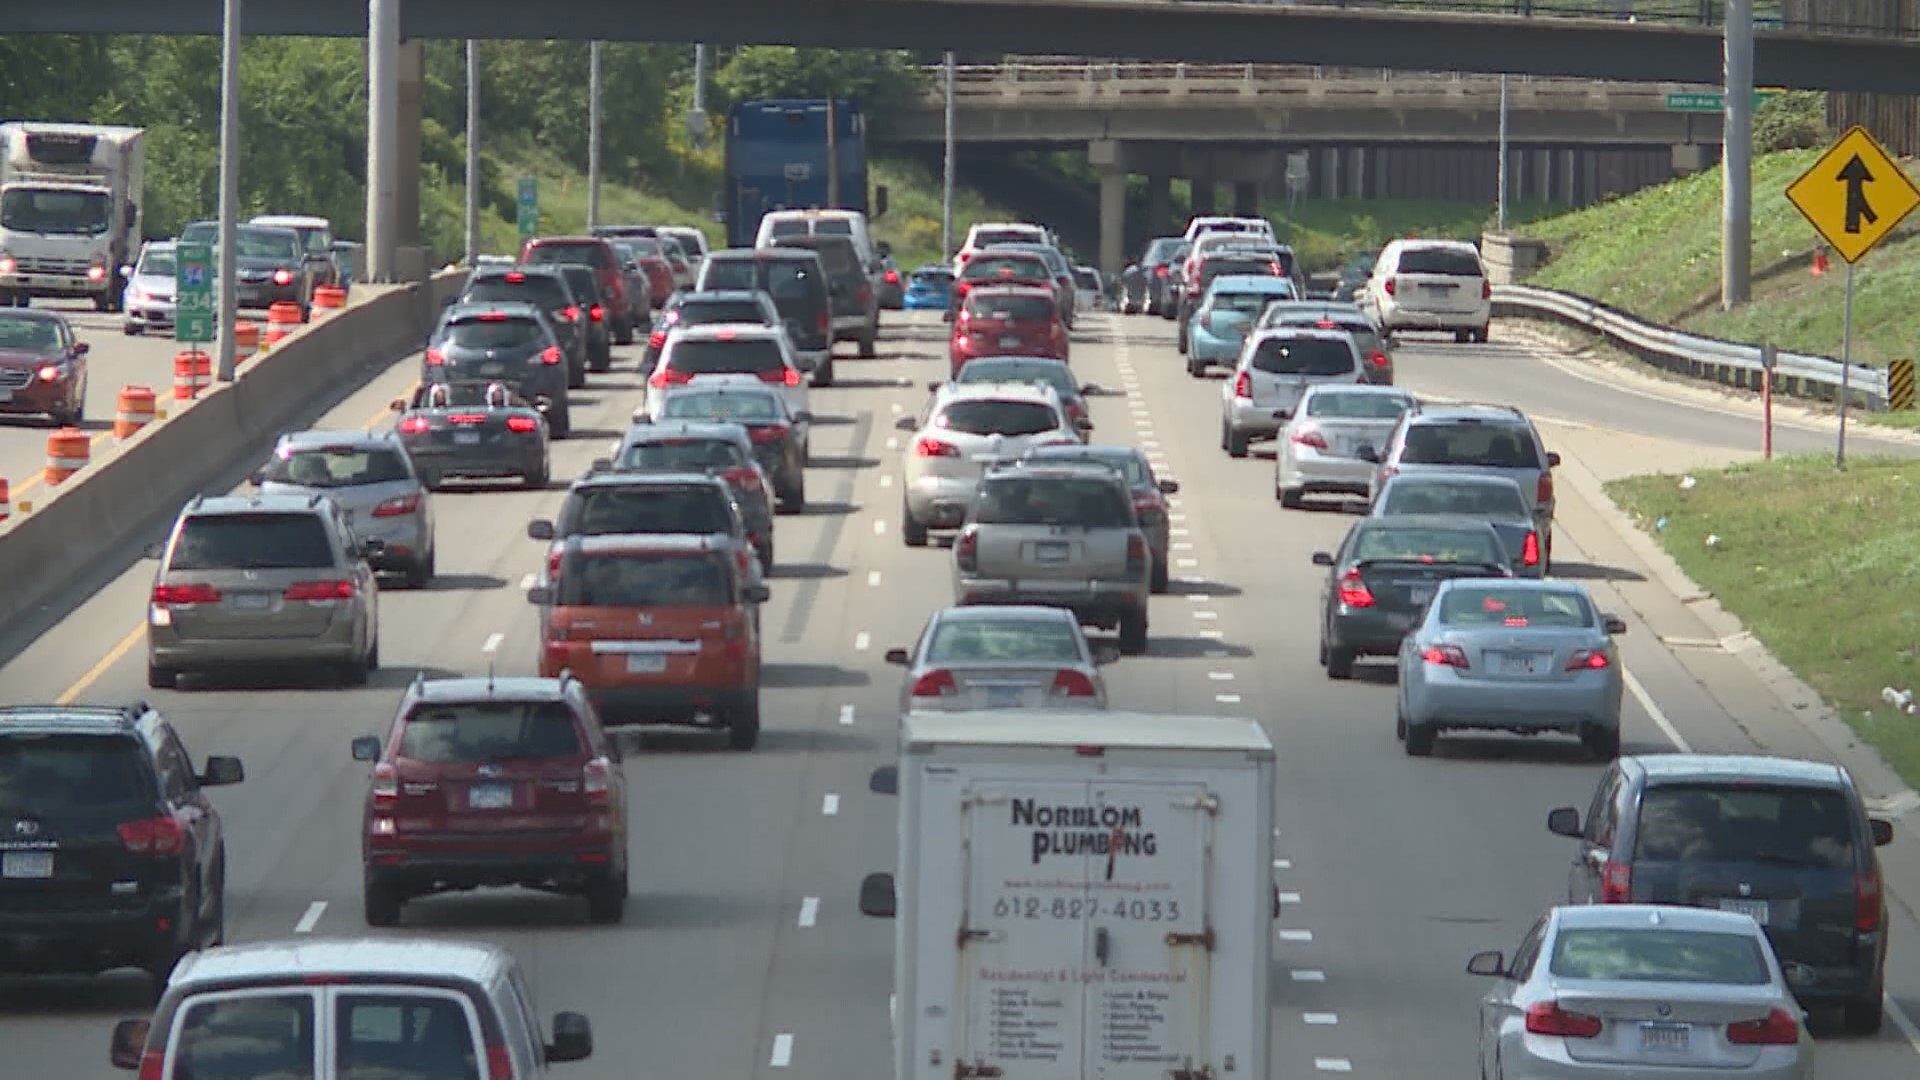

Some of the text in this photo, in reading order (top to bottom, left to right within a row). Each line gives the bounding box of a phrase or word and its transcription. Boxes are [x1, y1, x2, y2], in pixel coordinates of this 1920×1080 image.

[180, 291, 210, 310] 234
[1011, 797, 1142, 828] NORBLOM
[993, 896, 1181, 921] 612-827-4033
